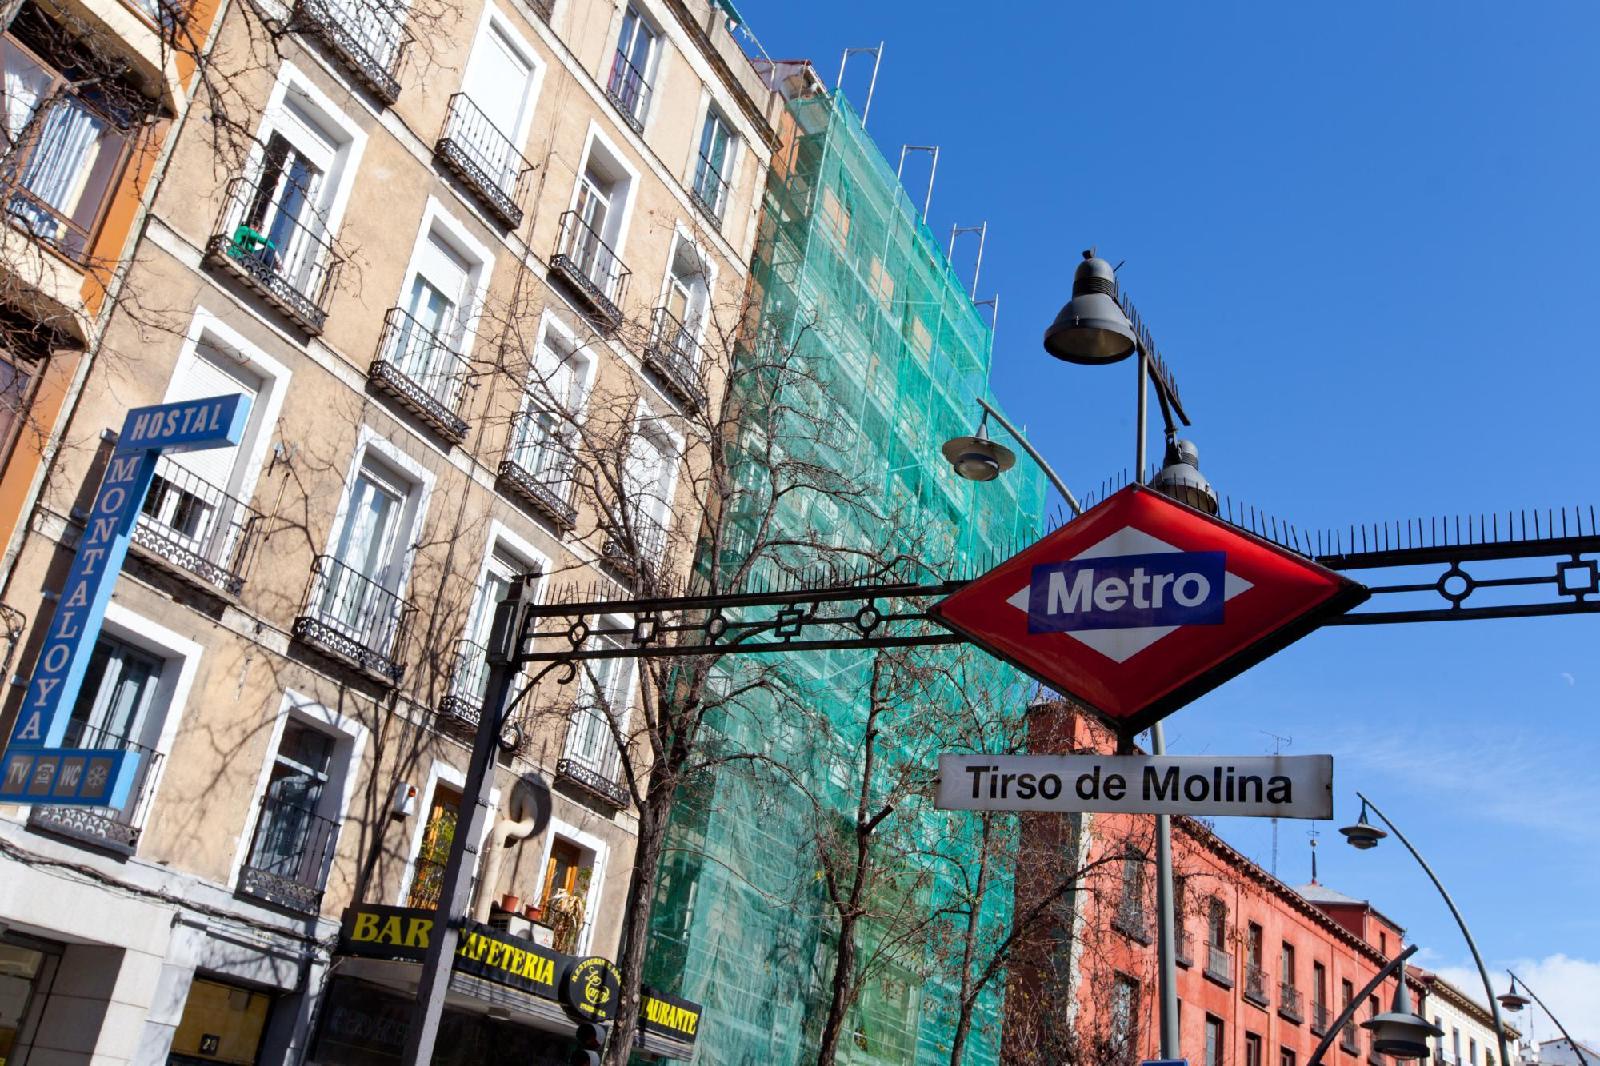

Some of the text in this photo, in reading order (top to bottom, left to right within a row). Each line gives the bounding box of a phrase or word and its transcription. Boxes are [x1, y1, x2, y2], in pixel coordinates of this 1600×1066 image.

[131, 407, 220, 440] HOSTAL
[18, 457, 141, 740] MONTALOYA
[1047, 568, 1211, 616] Metro
[9, 762, 81, 786] TV WC
[965, 766, 1293, 804] Tirso de Molina
[351, 912, 434, 949] BAR
[457, 928, 555, 986] AFETERIA
